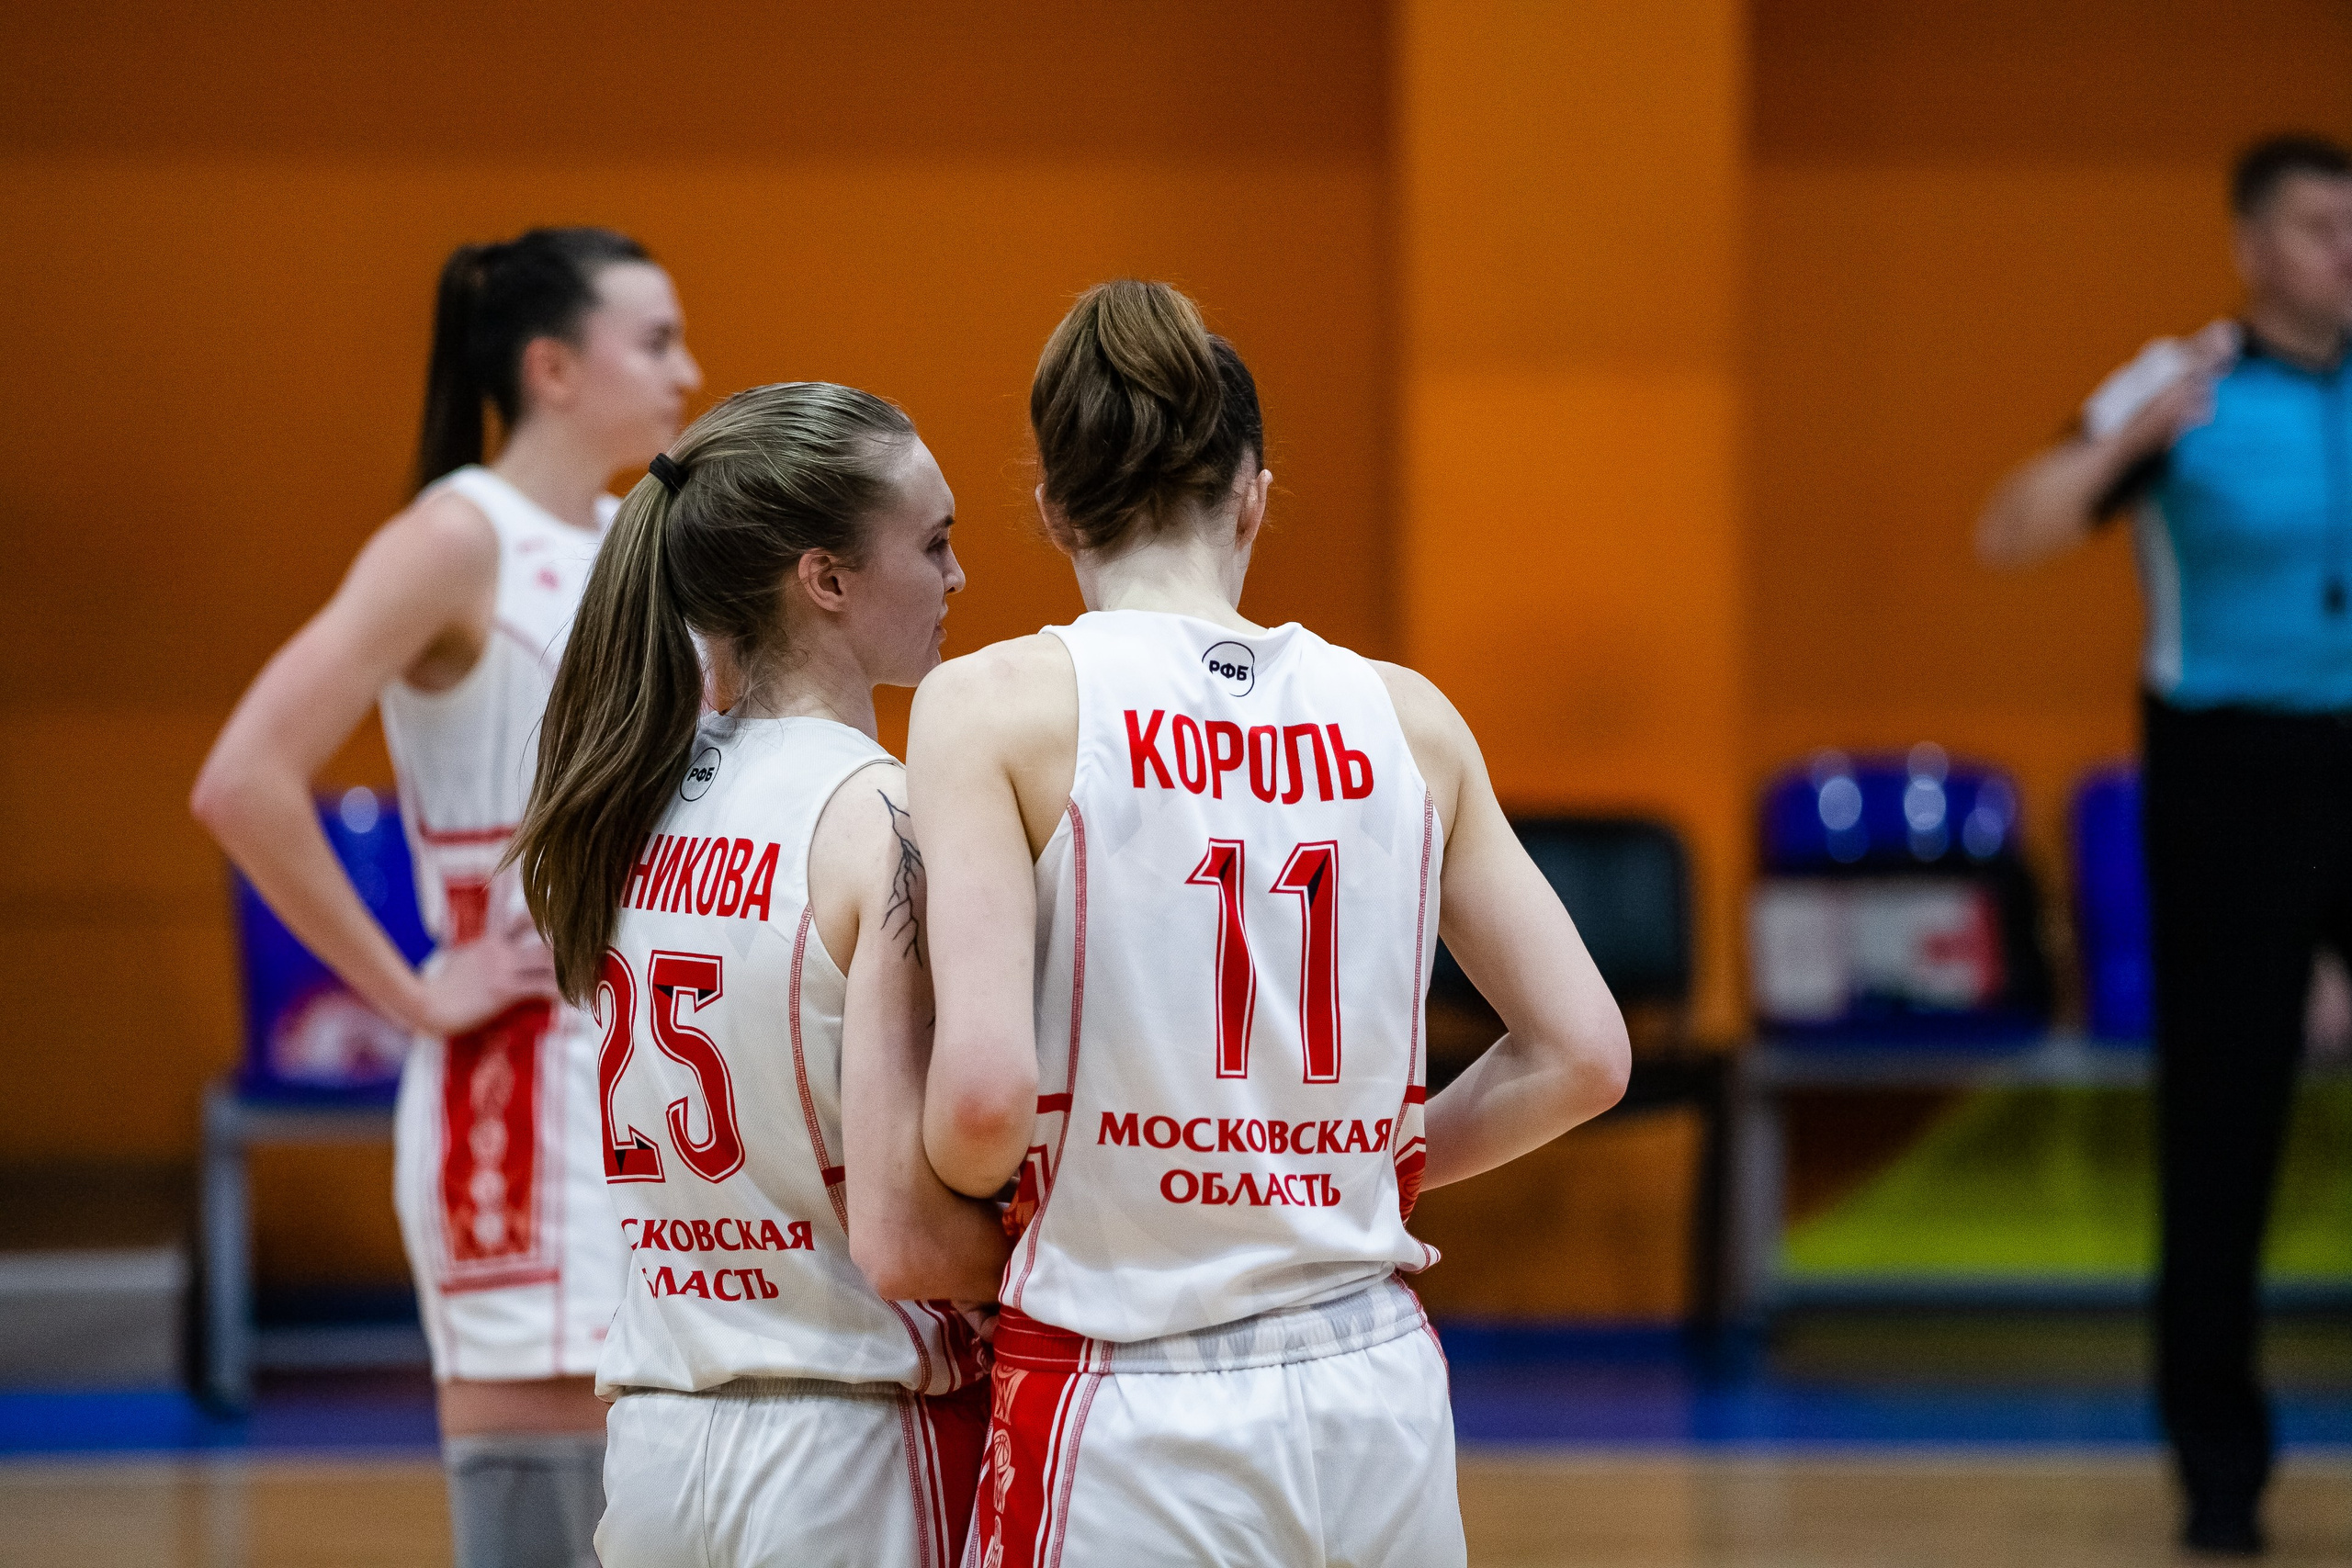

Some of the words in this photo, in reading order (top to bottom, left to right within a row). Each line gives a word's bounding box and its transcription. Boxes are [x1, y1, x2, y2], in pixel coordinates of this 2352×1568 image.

[1209, 660, 1250, 682] РФБ
[686, 766, 716, 783] РФБ
[1123, 708, 1374, 806] КОРОЛЬ
[1184, 837, 1341, 1084] 11
[591, 944, 746, 1185] 25
[1096, 1111, 1394, 1156] МОСКОВСКАЯ
[1159, 1168, 1341, 1208] ОБЛАСТЬ
[641, 1265, 780, 1302] ЛАСТЬ
